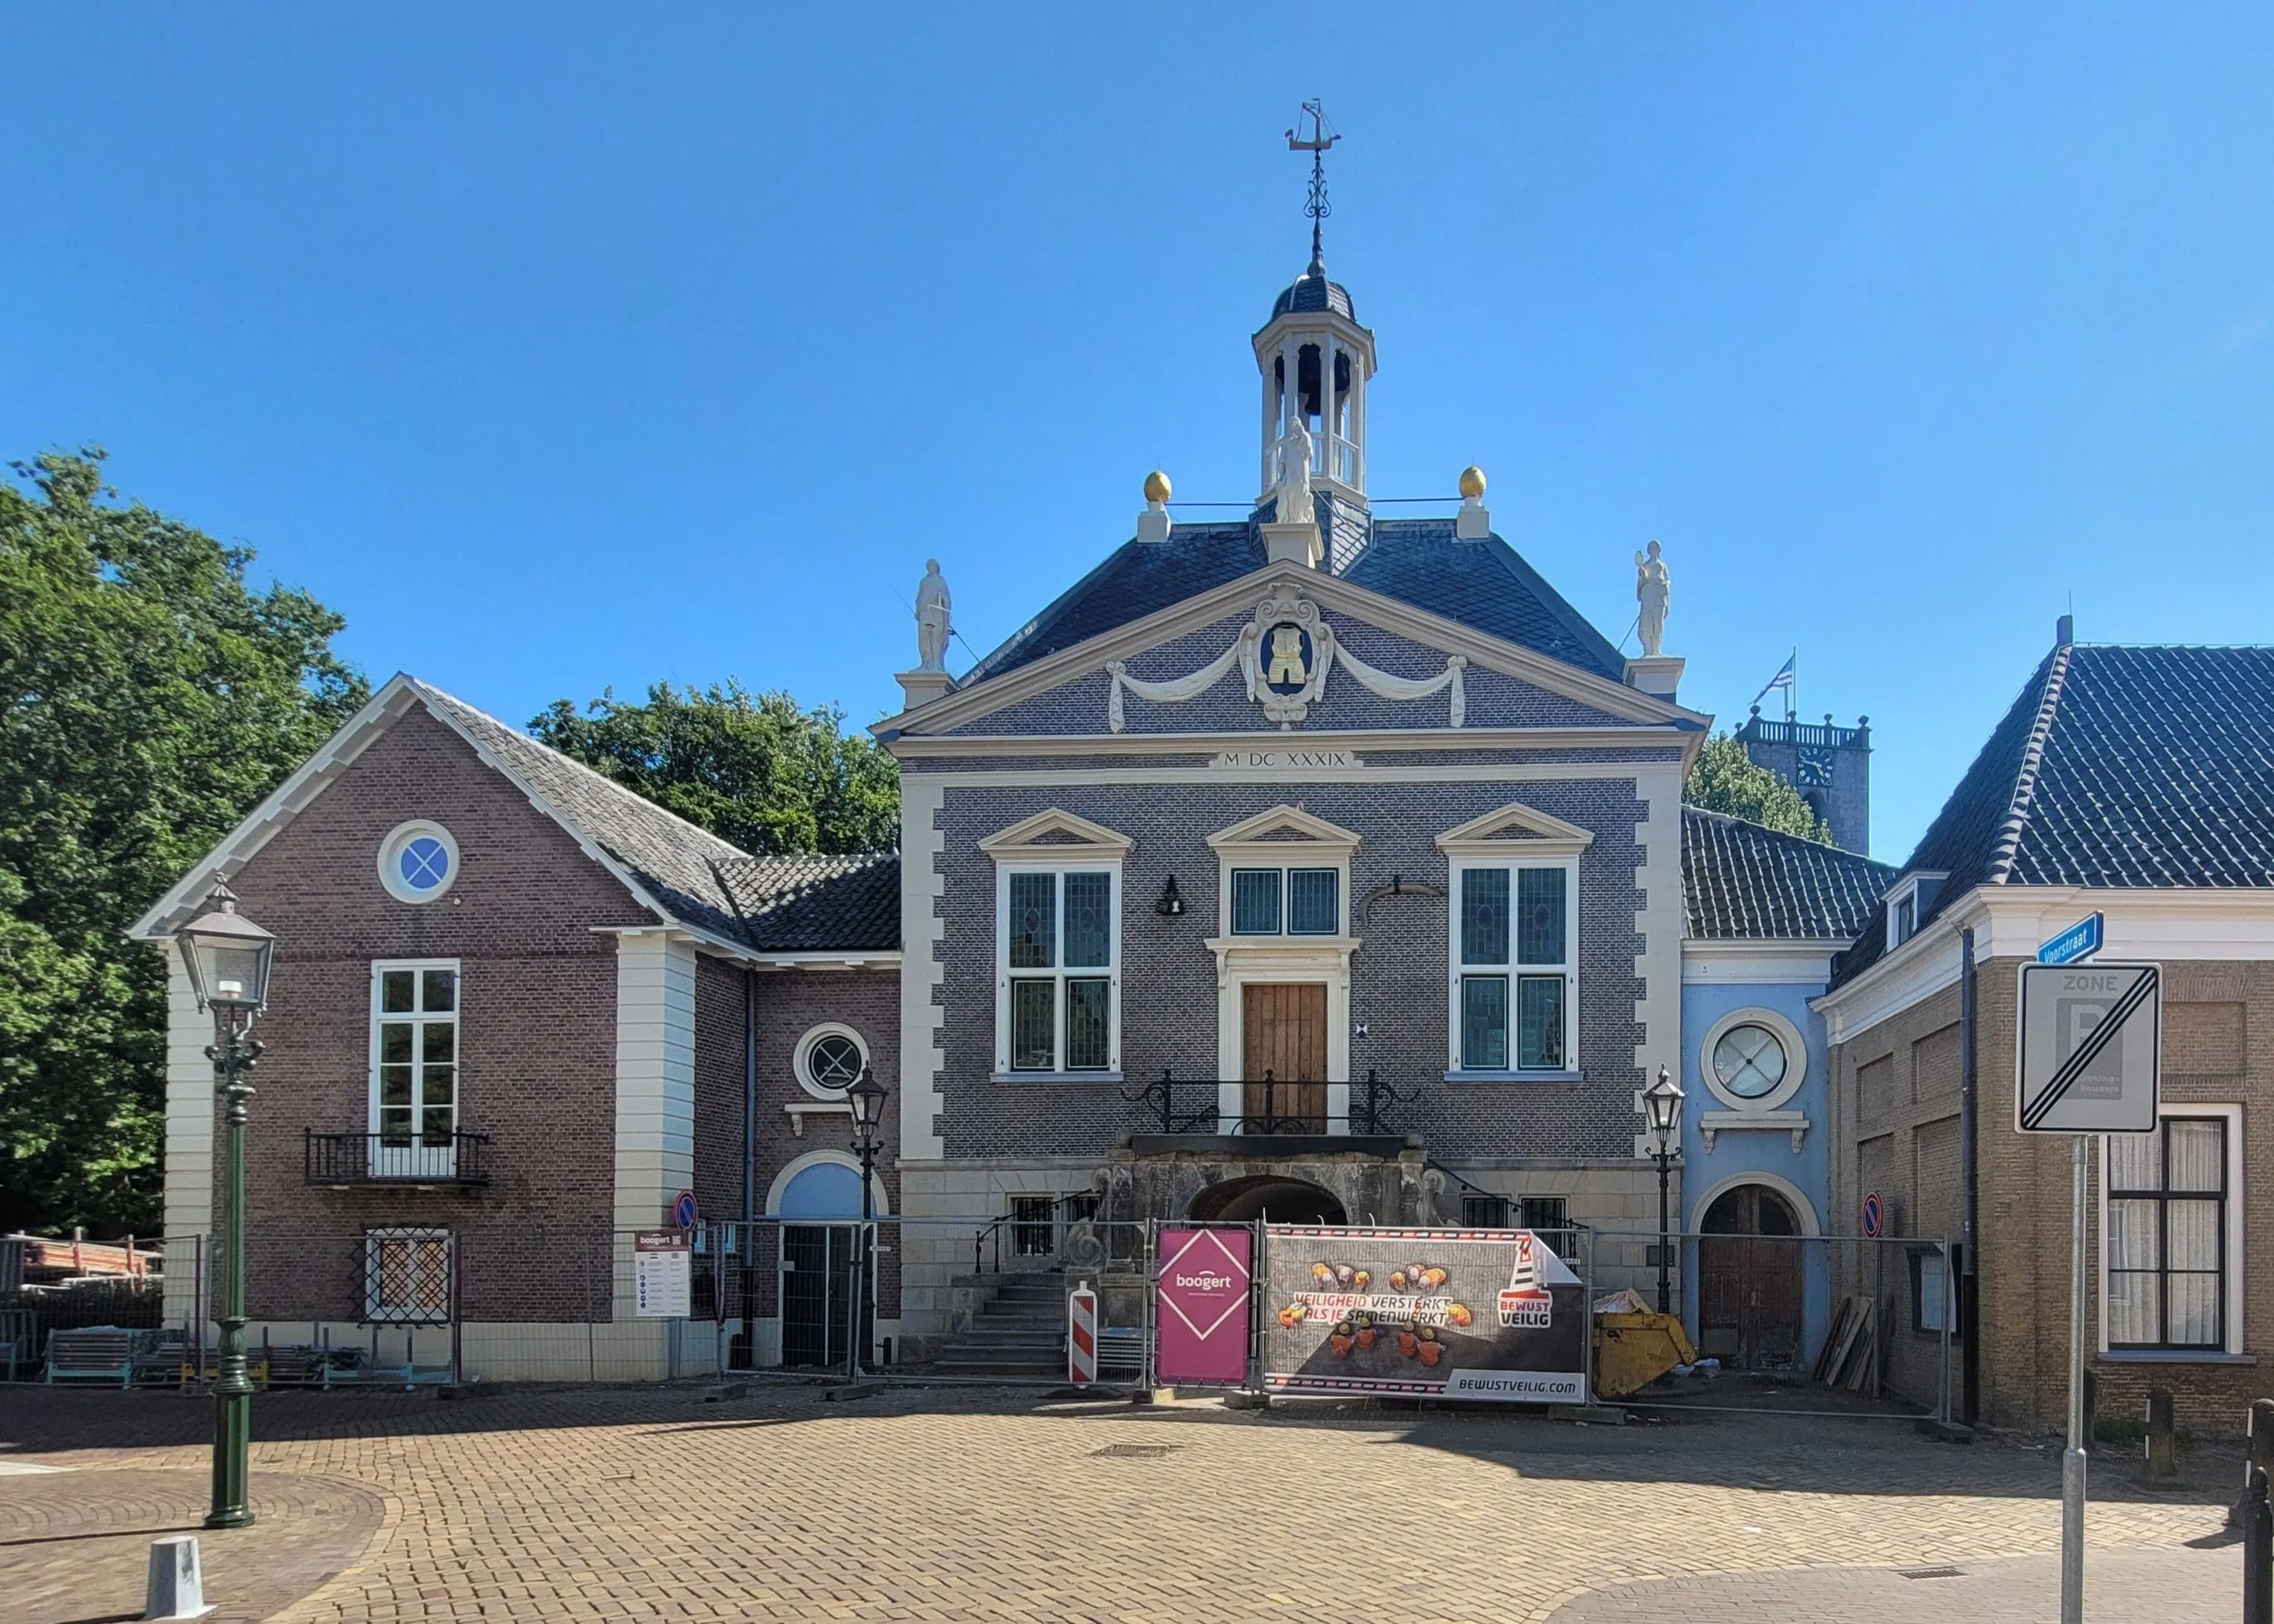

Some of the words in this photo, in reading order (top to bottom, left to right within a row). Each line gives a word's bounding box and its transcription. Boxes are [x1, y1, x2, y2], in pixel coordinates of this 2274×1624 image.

[1224, 753, 1239, 766] M
[1250, 753, 1276, 766] DC
[1287, 753, 1345, 766] XXXIX
[2044, 926, 2088, 963] Voorstraat
[2063, 975, 2118, 992] ZONE
[640, 1236, 671, 1246] boogert
[1176, 1273, 1232, 1290] boogert
[1295, 1294, 1367, 1307] VEILIGHEID
[1371, 1296, 1449, 1310] VERSTERKT
[1500, 1301, 1550, 1312] BEWUST
[1304, 1308, 1329, 1319] ALS
[1330, 1309, 1344, 1322] JE
[1348, 1309, 1447, 1324] SAMENWERKT
[1501, 1312, 1549, 1325] VEILIG
[1459, 1379, 1576, 1394] BEWUSTVEILIG.COM
